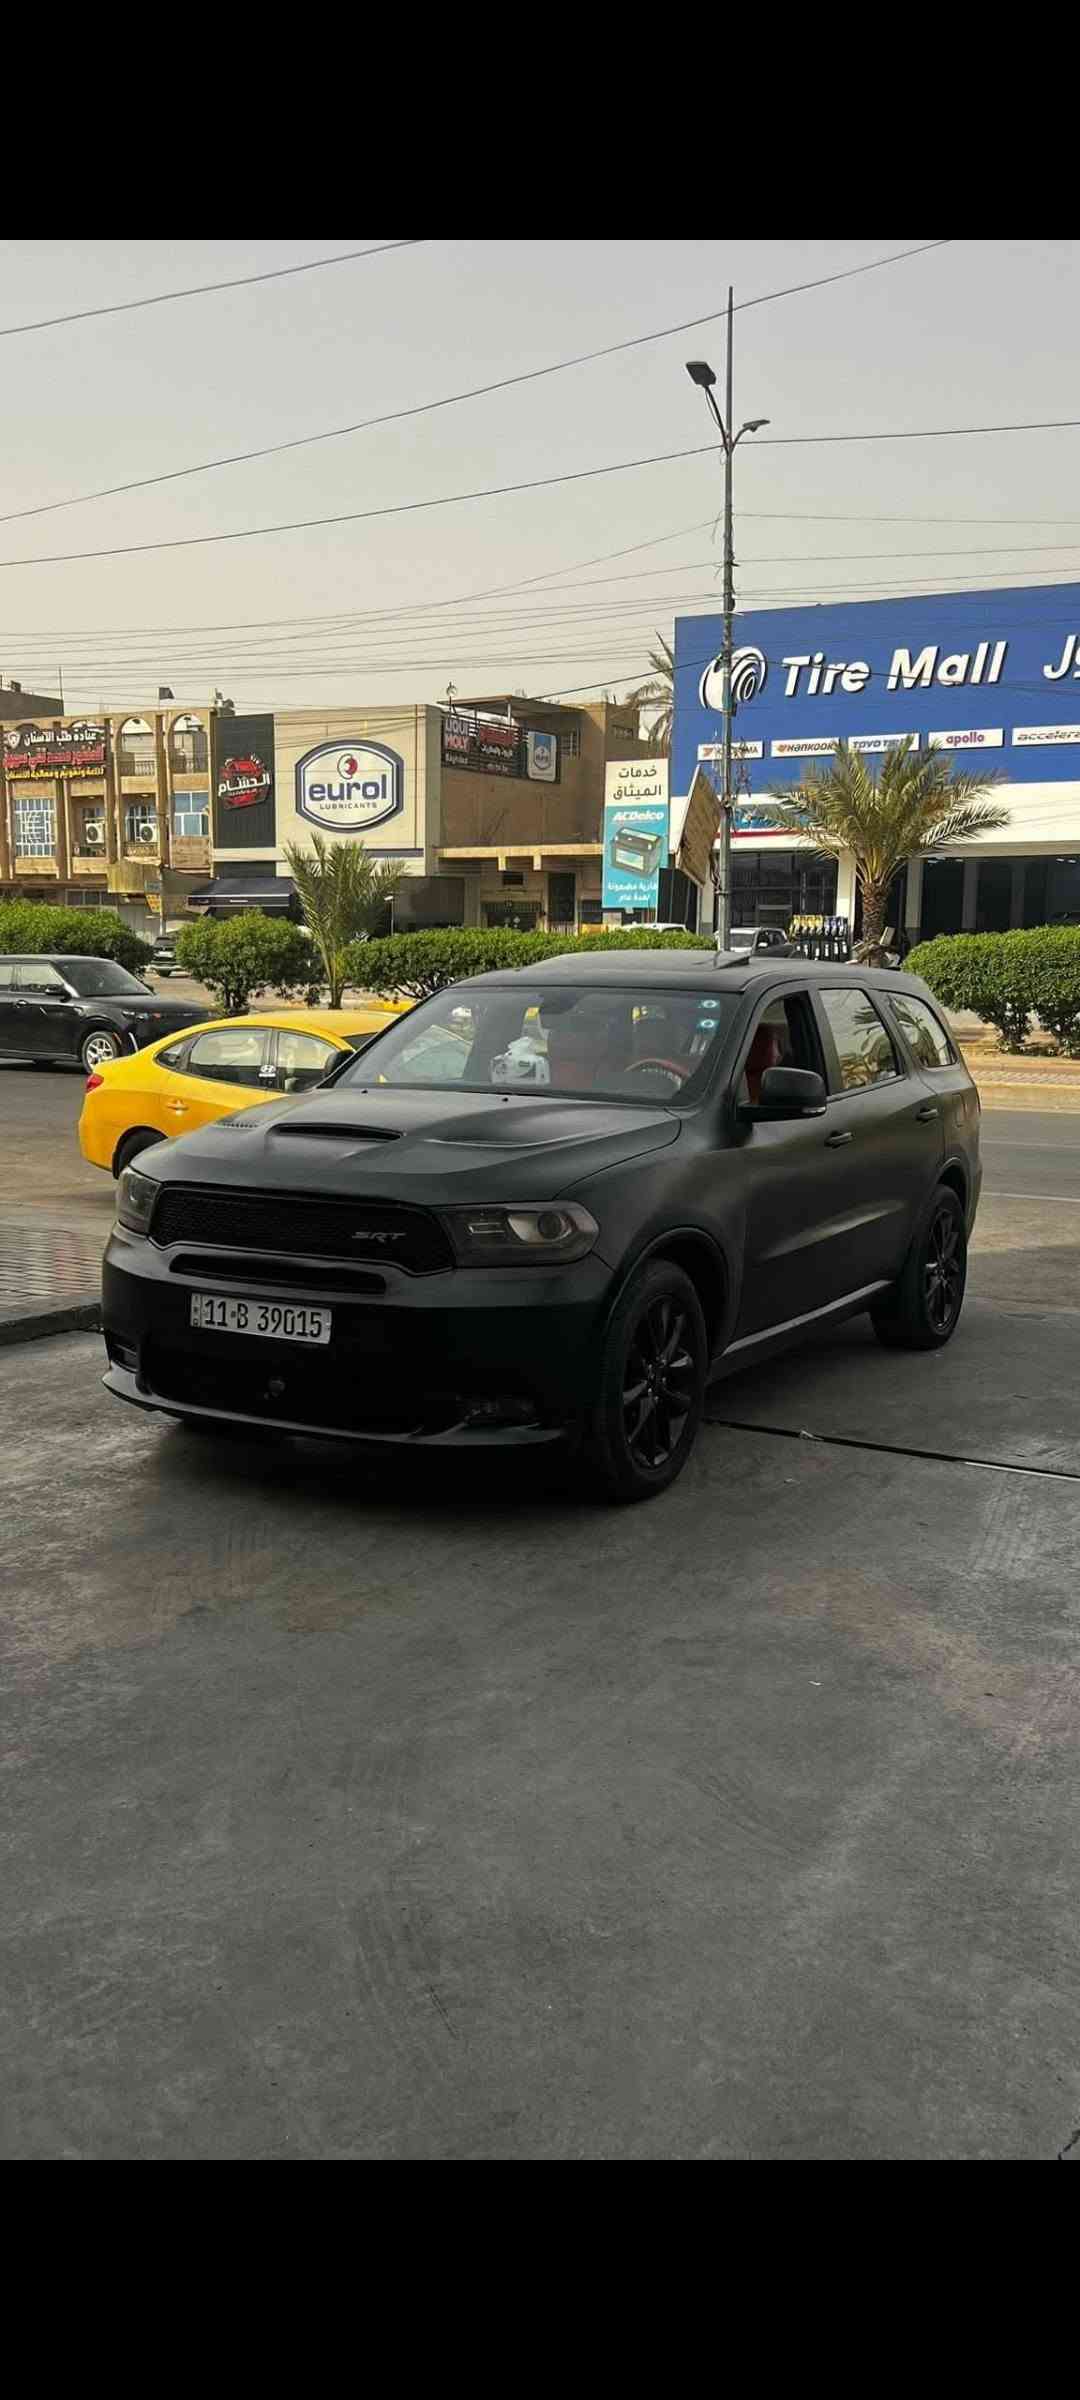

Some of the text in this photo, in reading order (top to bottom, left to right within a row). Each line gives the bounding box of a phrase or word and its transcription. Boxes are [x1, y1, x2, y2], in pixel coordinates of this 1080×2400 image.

[782, 641, 1007, 697] Tire Mall
[946, 732, 985, 747] apollo
[618, 765, 657, 778] خدمات
[309, 774, 387, 801] eurol
[613, 784, 662, 800] الميثاق
[320, 802, 378, 810] LUBRICANTS
[613, 810, 665, 822] ACDelco
[352, 1231, 407, 1243] SRT
[257, 1305, 322, 1338] 39015
